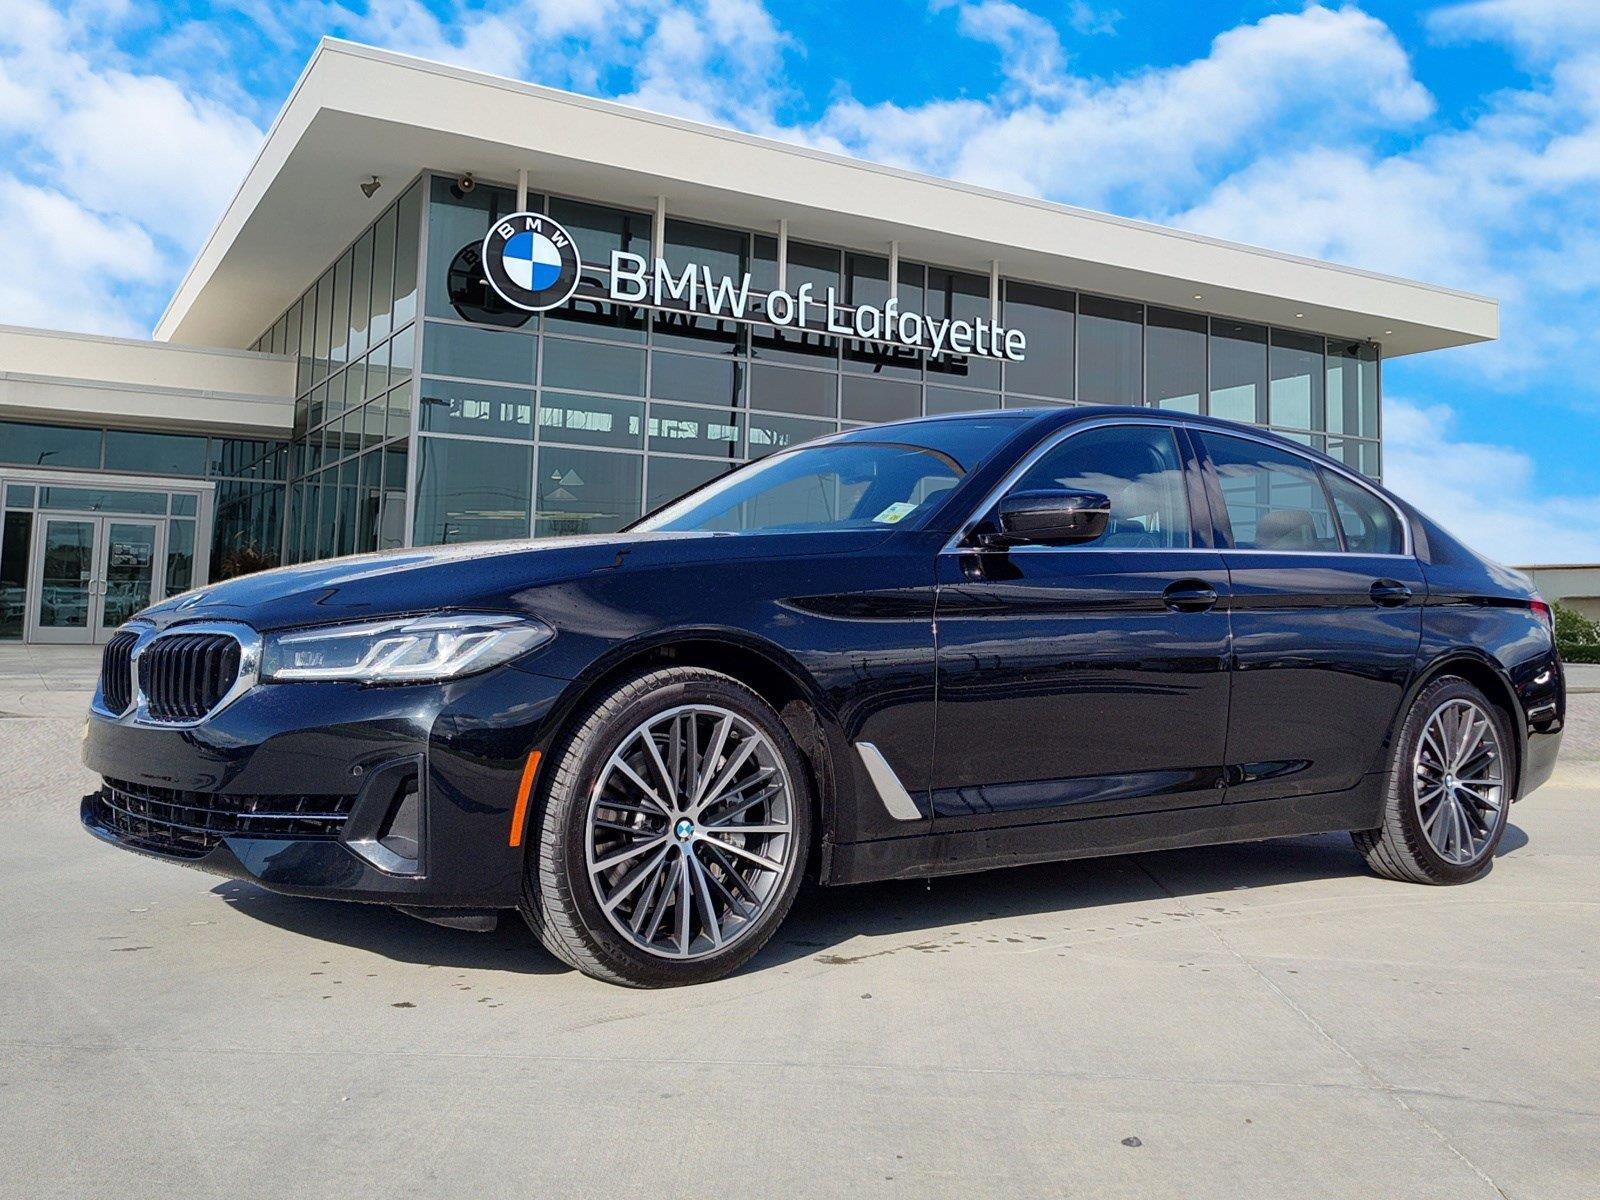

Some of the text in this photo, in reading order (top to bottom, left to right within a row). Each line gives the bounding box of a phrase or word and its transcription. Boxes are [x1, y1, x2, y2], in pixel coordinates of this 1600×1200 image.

[497, 217, 569, 248] BMW
[609, 249, 752, 318] BMW
[766, 282, 813, 327] of
[826, 286, 1027, 361] Lafayette
